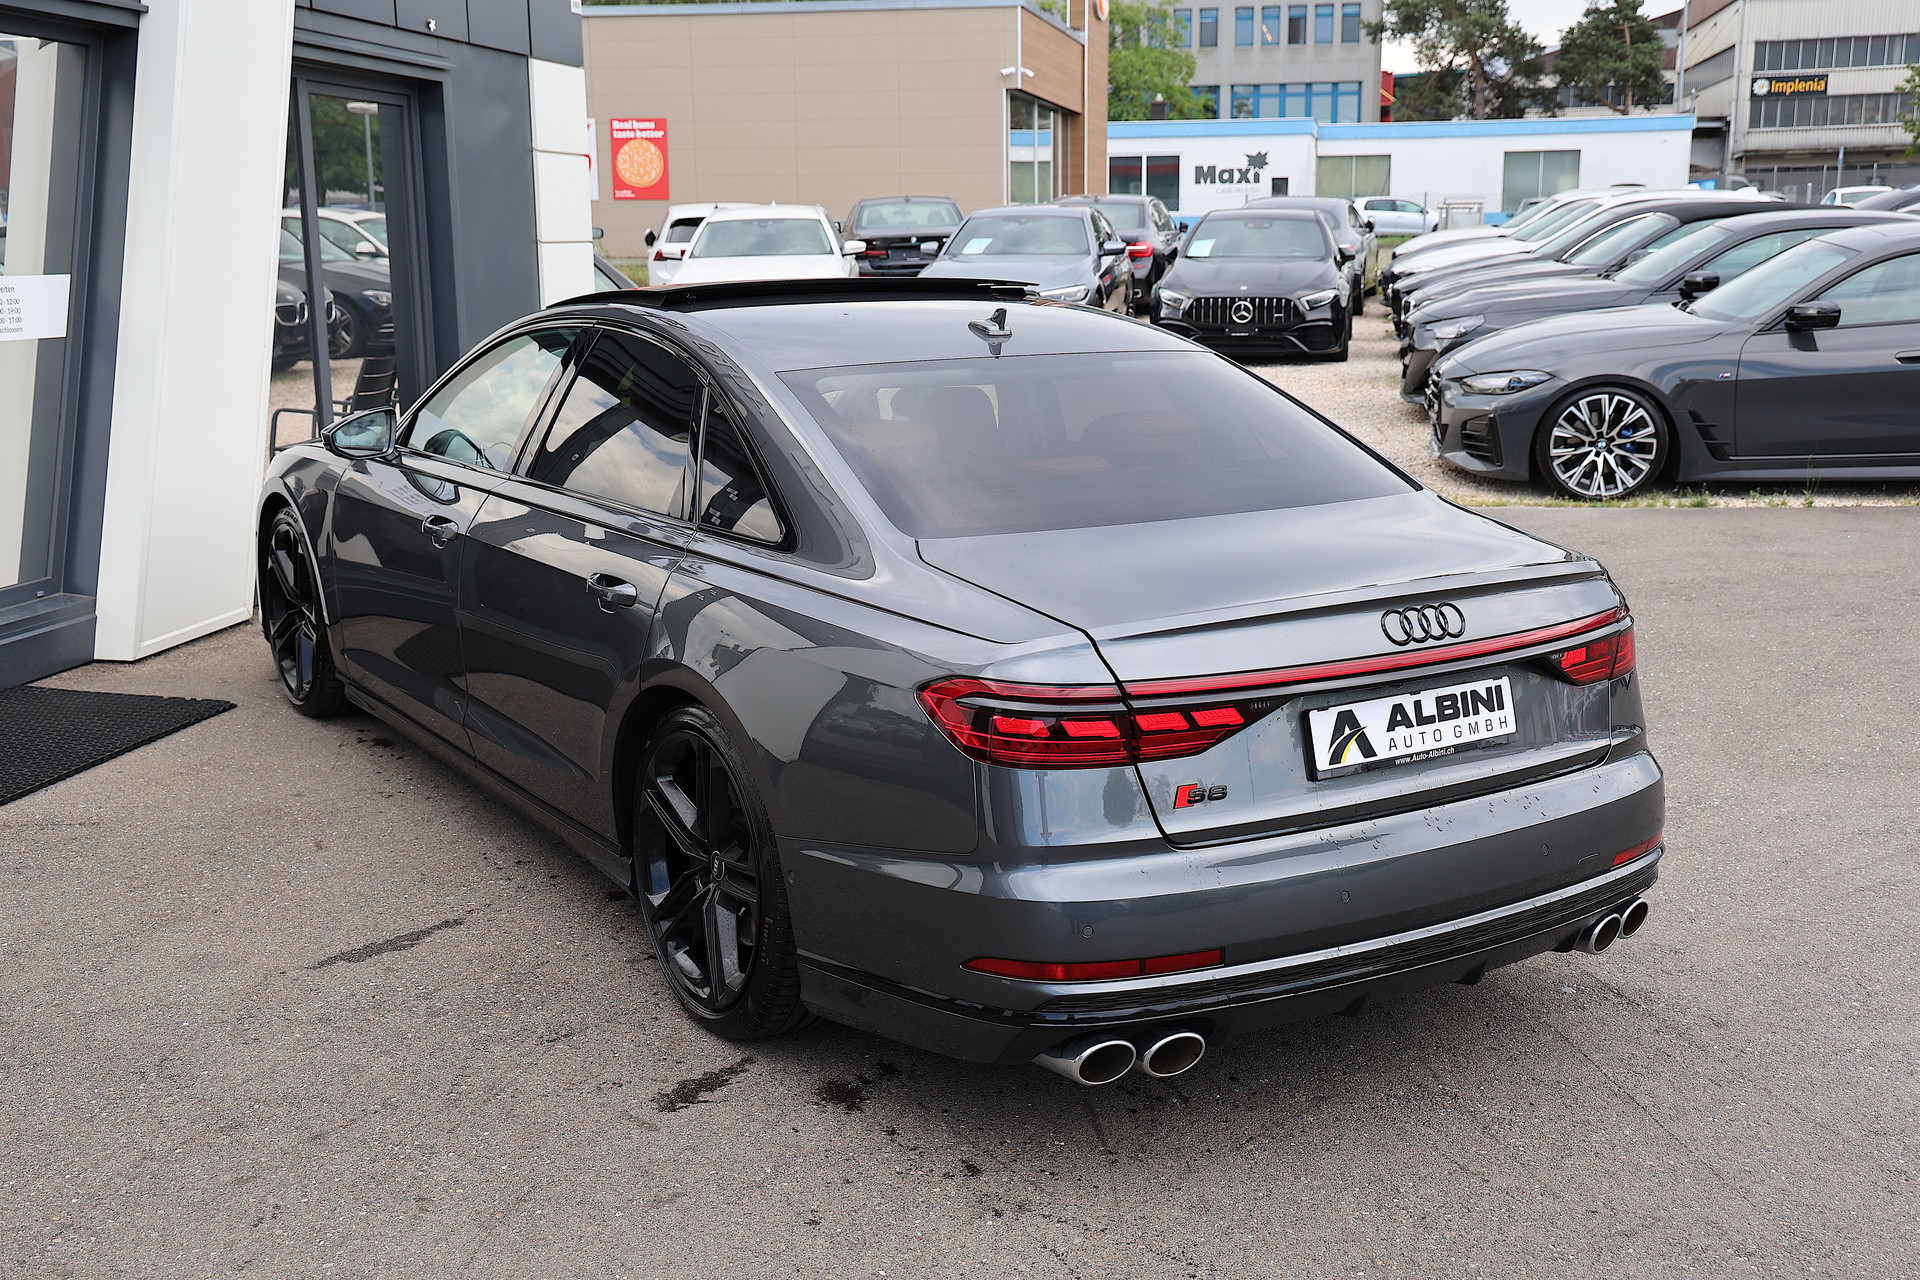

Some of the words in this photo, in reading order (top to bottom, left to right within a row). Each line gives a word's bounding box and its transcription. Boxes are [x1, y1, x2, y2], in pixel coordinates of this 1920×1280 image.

[1771, 78, 1826, 96] Implenia
[612, 120, 632, 129] Real
[633, 120, 655, 129] buns
[613, 130, 635, 139] taste
[635, 129, 664, 139] better
[1195, 165, 1260, 184] Maxi
[1386, 685, 1505, 732] ALBINI
[1389, 729, 1442, 751] AUTO
[1454, 715, 1508, 738] GMBH
[1395, 747, 1455, 765] www.Auto-Albini.ch
[1181, 784, 1228, 806] S8
